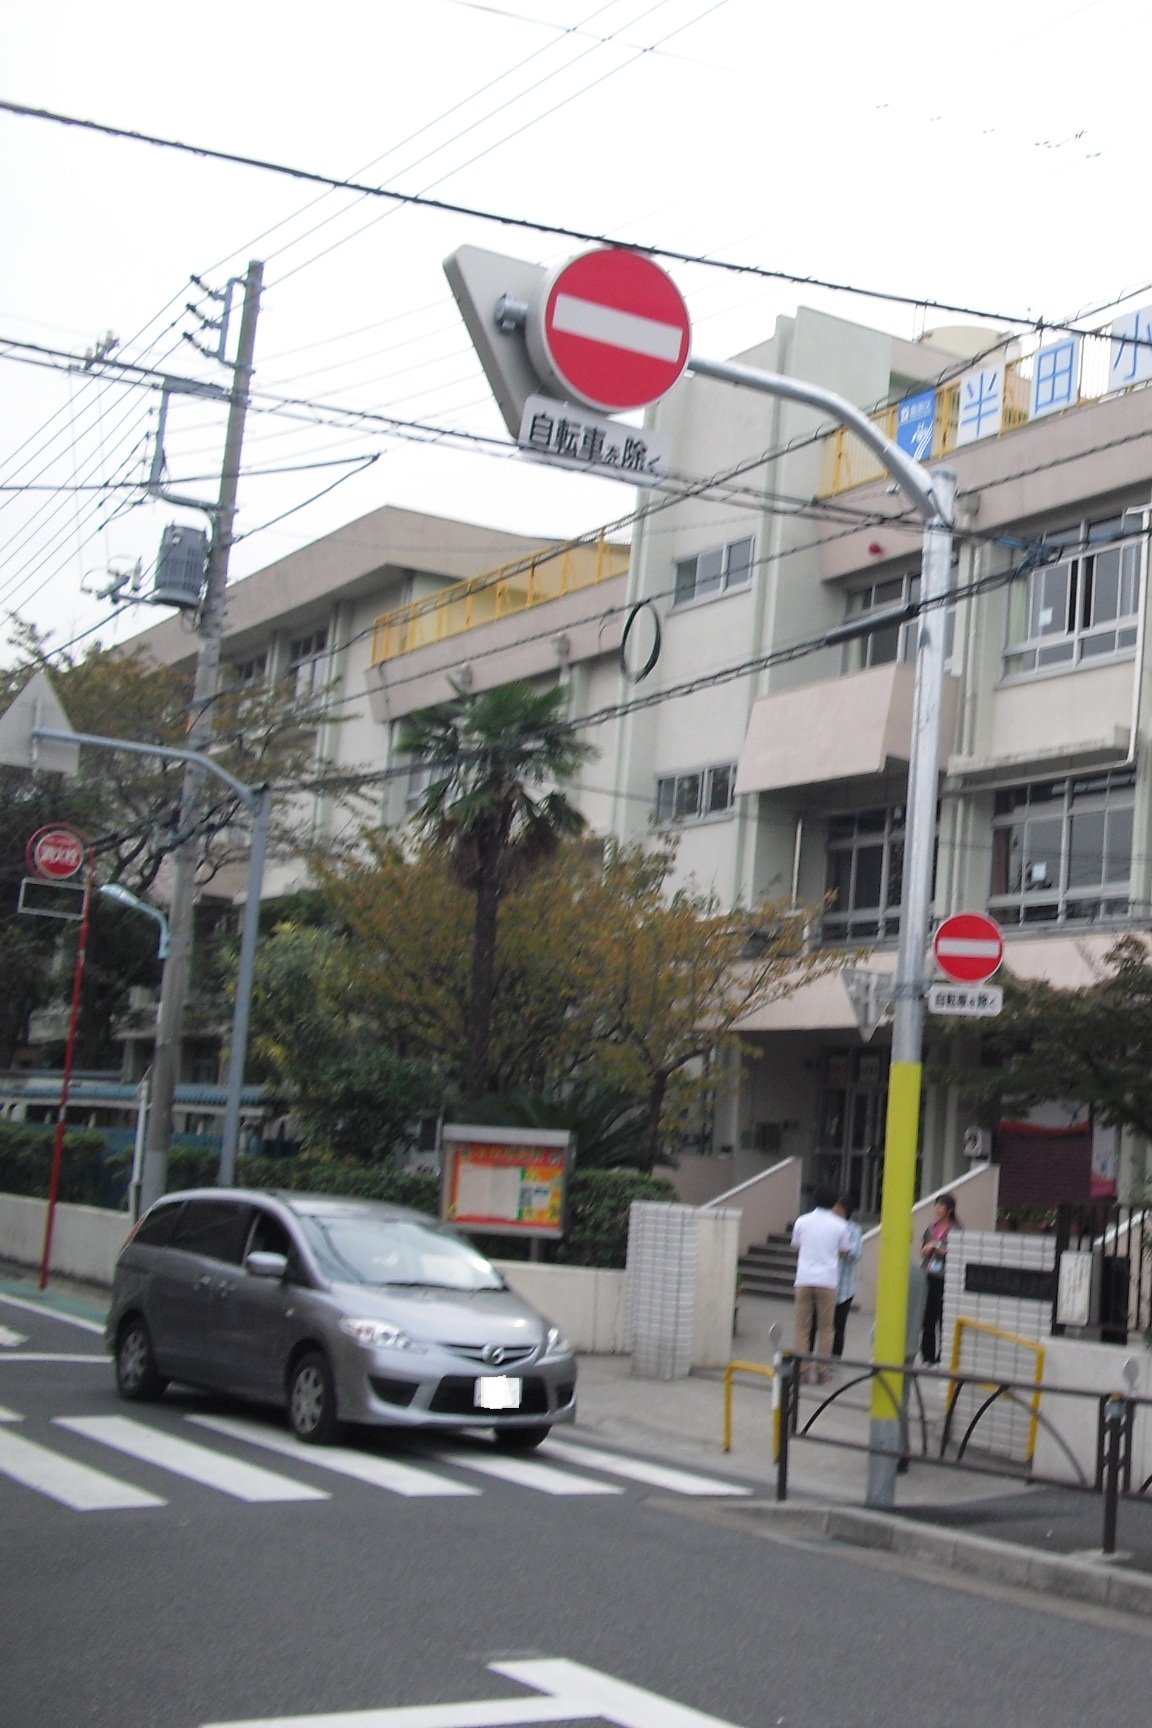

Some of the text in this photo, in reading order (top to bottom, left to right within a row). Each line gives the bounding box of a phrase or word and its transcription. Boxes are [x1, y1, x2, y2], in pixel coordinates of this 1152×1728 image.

[530, 412, 662, 474] 自転車を除く
